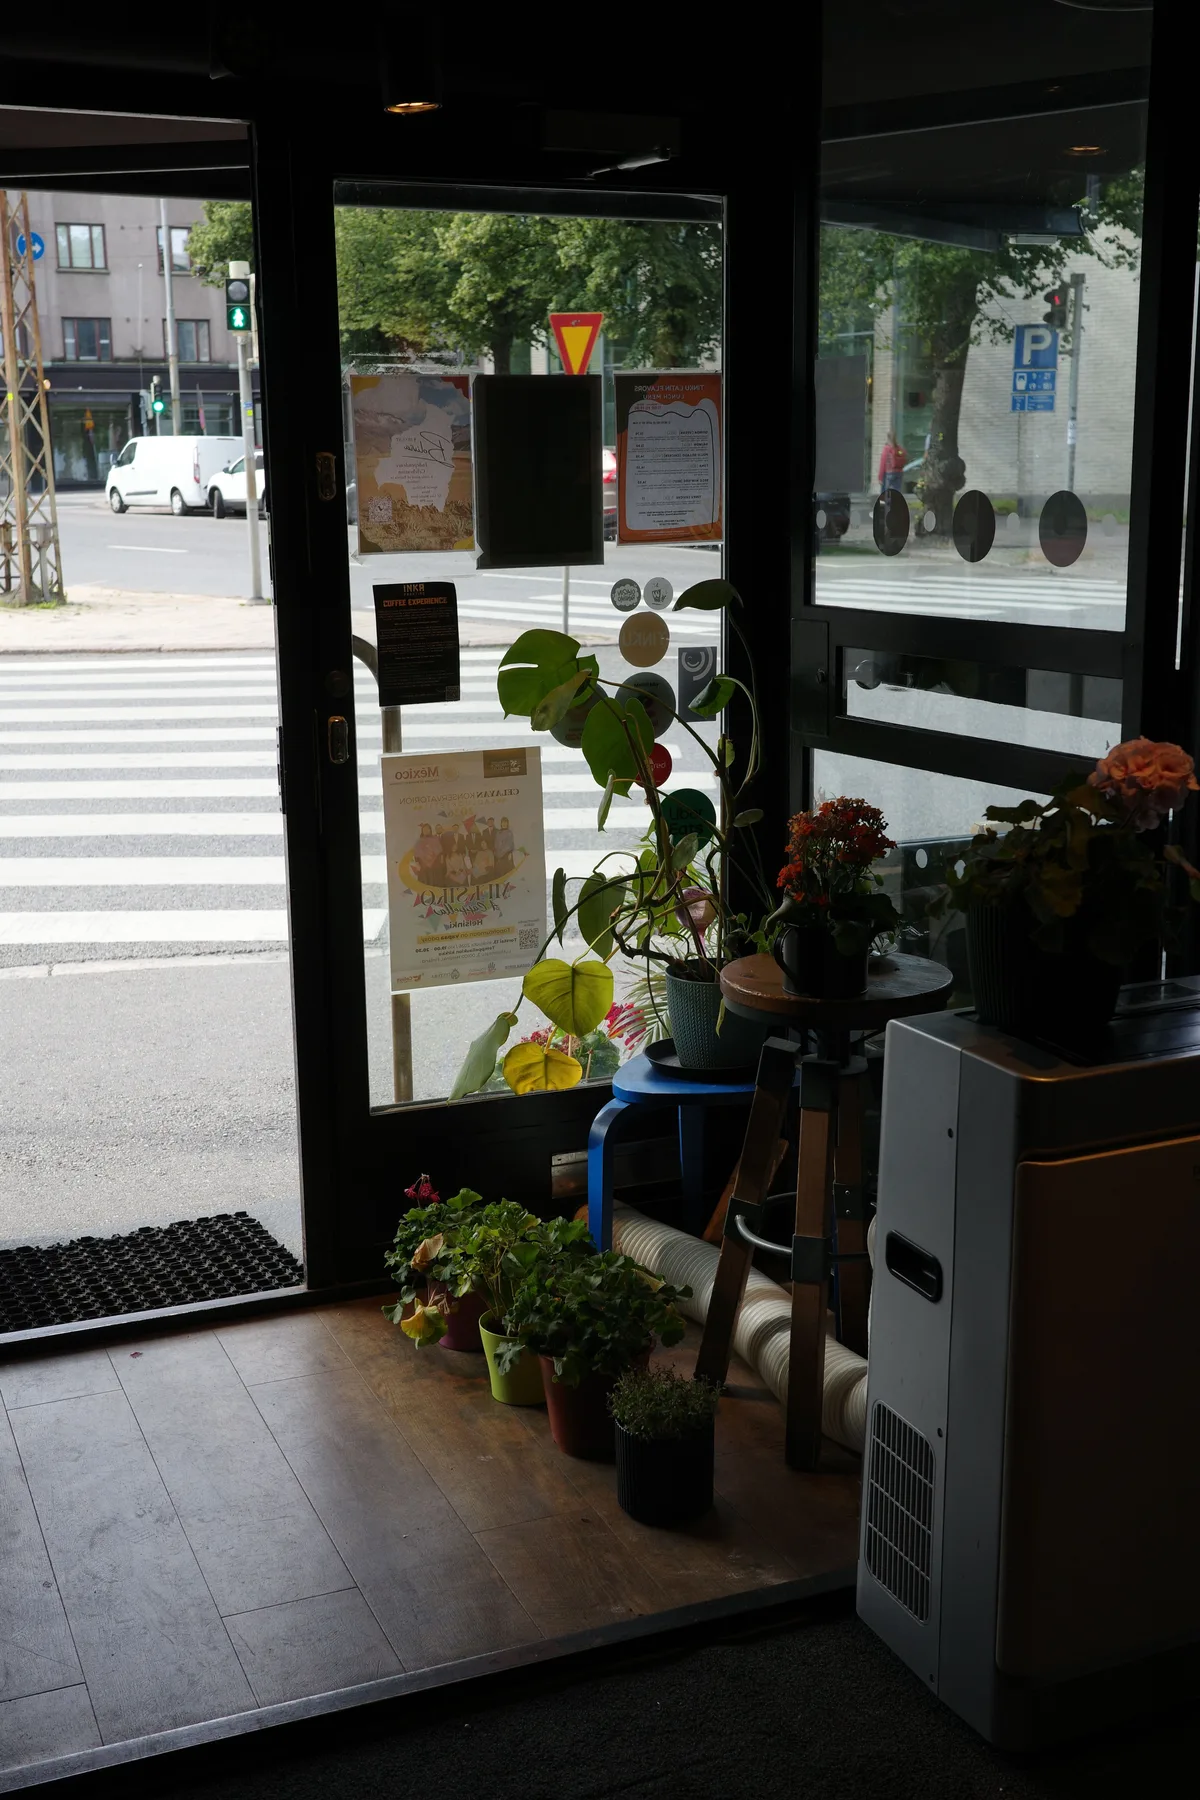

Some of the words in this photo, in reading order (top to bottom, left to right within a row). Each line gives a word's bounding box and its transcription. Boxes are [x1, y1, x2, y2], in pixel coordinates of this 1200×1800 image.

[1022, 328, 1052, 365] P
[404, 584, 425, 592] INKA
[383, 598, 406, 608] COFFEE
[408, 596, 448, 606] EXPERIENCE
